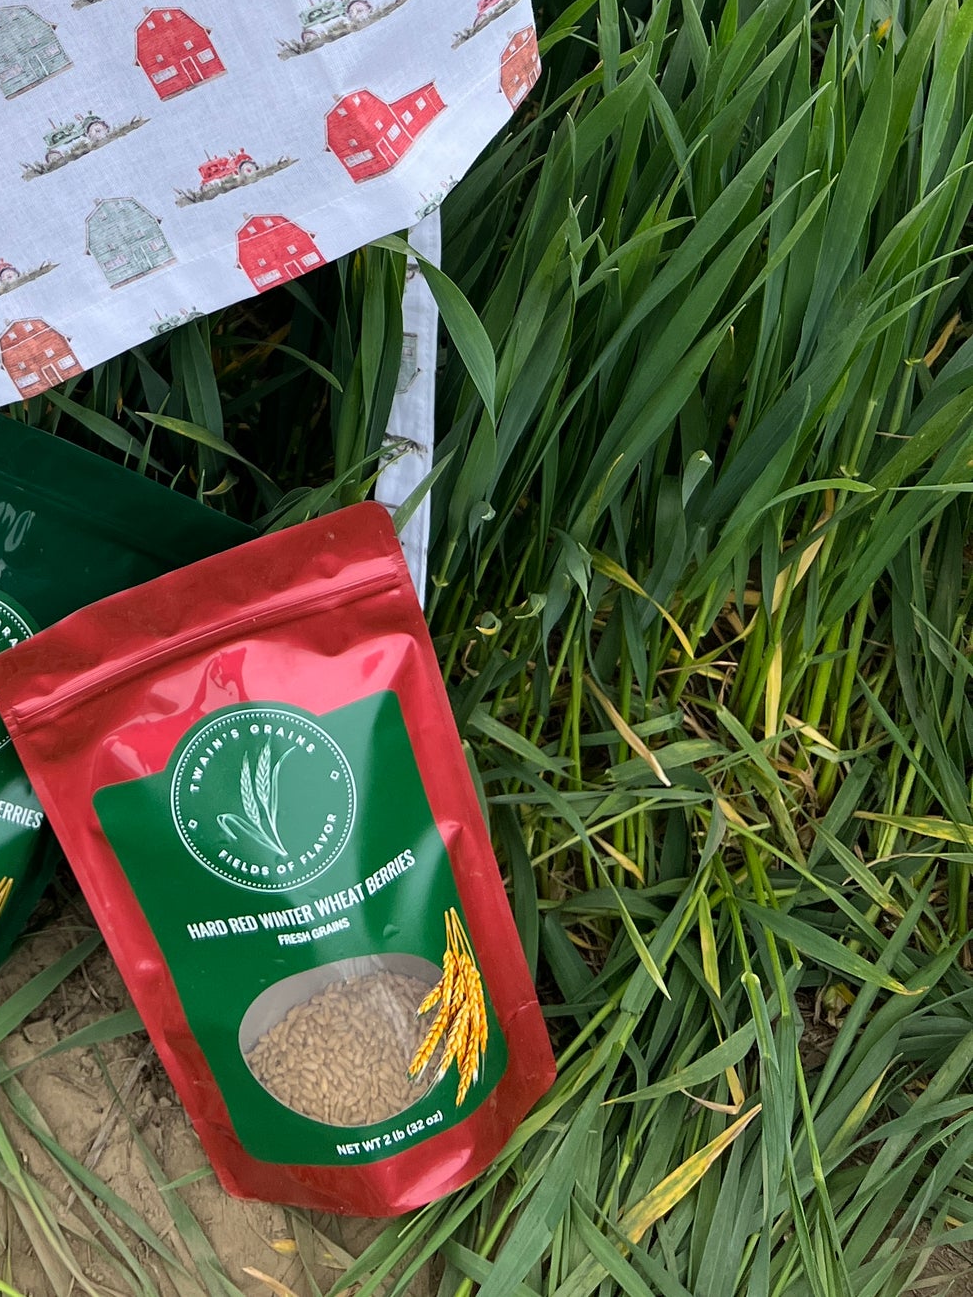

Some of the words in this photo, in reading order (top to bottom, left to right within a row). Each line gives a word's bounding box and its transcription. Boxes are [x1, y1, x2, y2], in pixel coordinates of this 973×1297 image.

[189, 728, 240, 793] TWAIN'S
[249, 724, 316, 753] GRAINS
[218, 849, 270, 876] FIELDS
[276, 861, 296, 875] OF
[299, 813, 337, 865] FLAVOR
[186, 920, 228, 941] HARD
[227, 914, 259, 935] RED
[257, 904, 315, 931] WINTER
[314, 882, 365, 918] WHEAT
[364, 848, 416, 896] BERRIES
[277, 931, 312, 947] FRESH
[311, 917, 350, 940] GRAINS
[336, 1143, 360, 1156] NET
[361, 1137, 381, 1153] WT
[382, 1134, 392, 1146] 2
[391, 1129, 406, 1142] lb
[406, 1119, 426, 1136] (32
[425, 1109, 444, 1126] oz)
